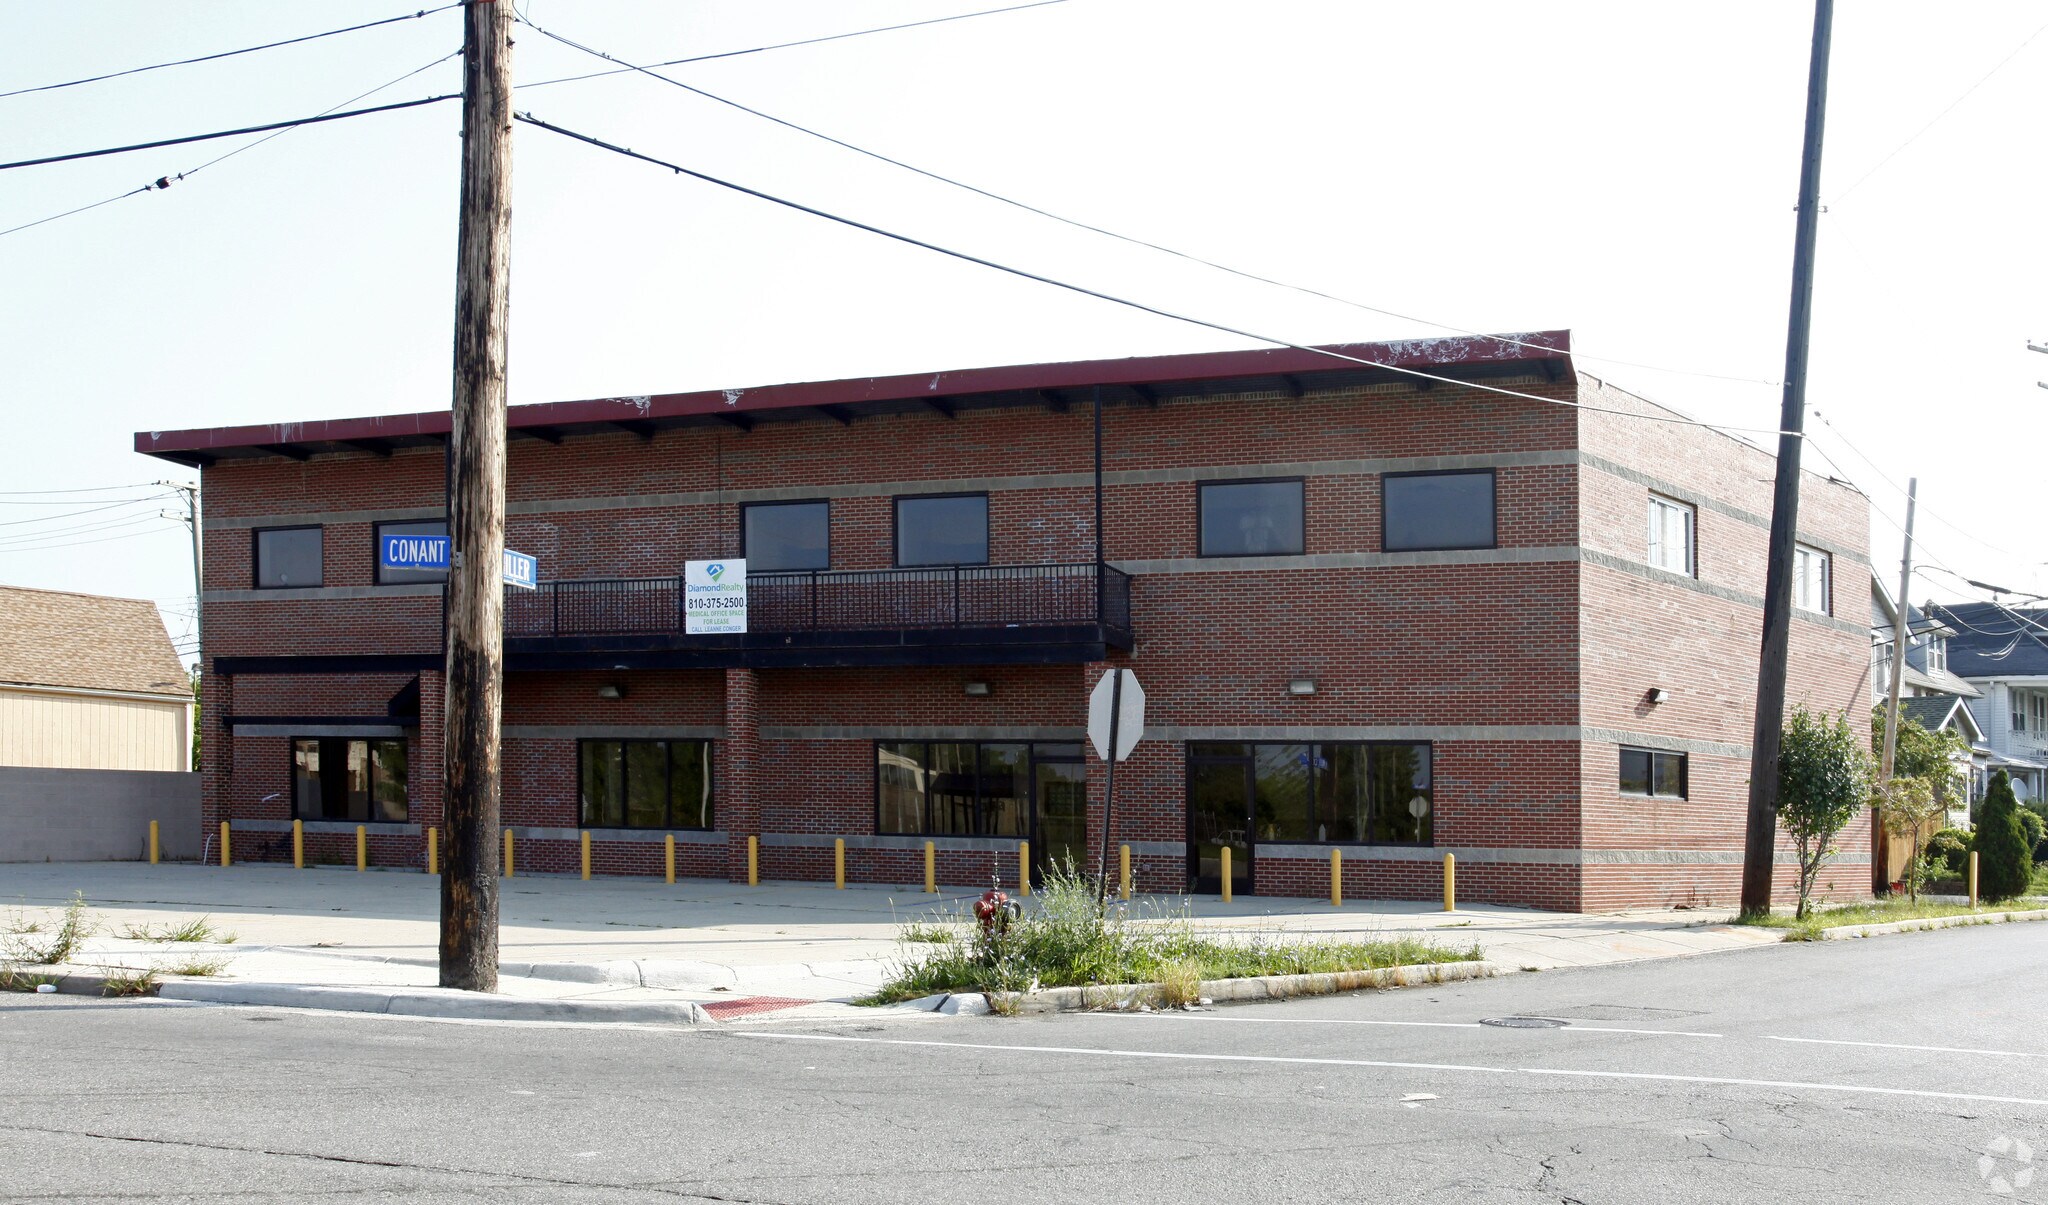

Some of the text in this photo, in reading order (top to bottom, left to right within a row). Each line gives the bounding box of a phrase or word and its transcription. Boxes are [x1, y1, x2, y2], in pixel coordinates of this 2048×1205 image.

[389, 539, 446, 563] CONANT
[504, 551, 530, 582] ILLER
[688, 597, 744, 609] 810-375-2500
